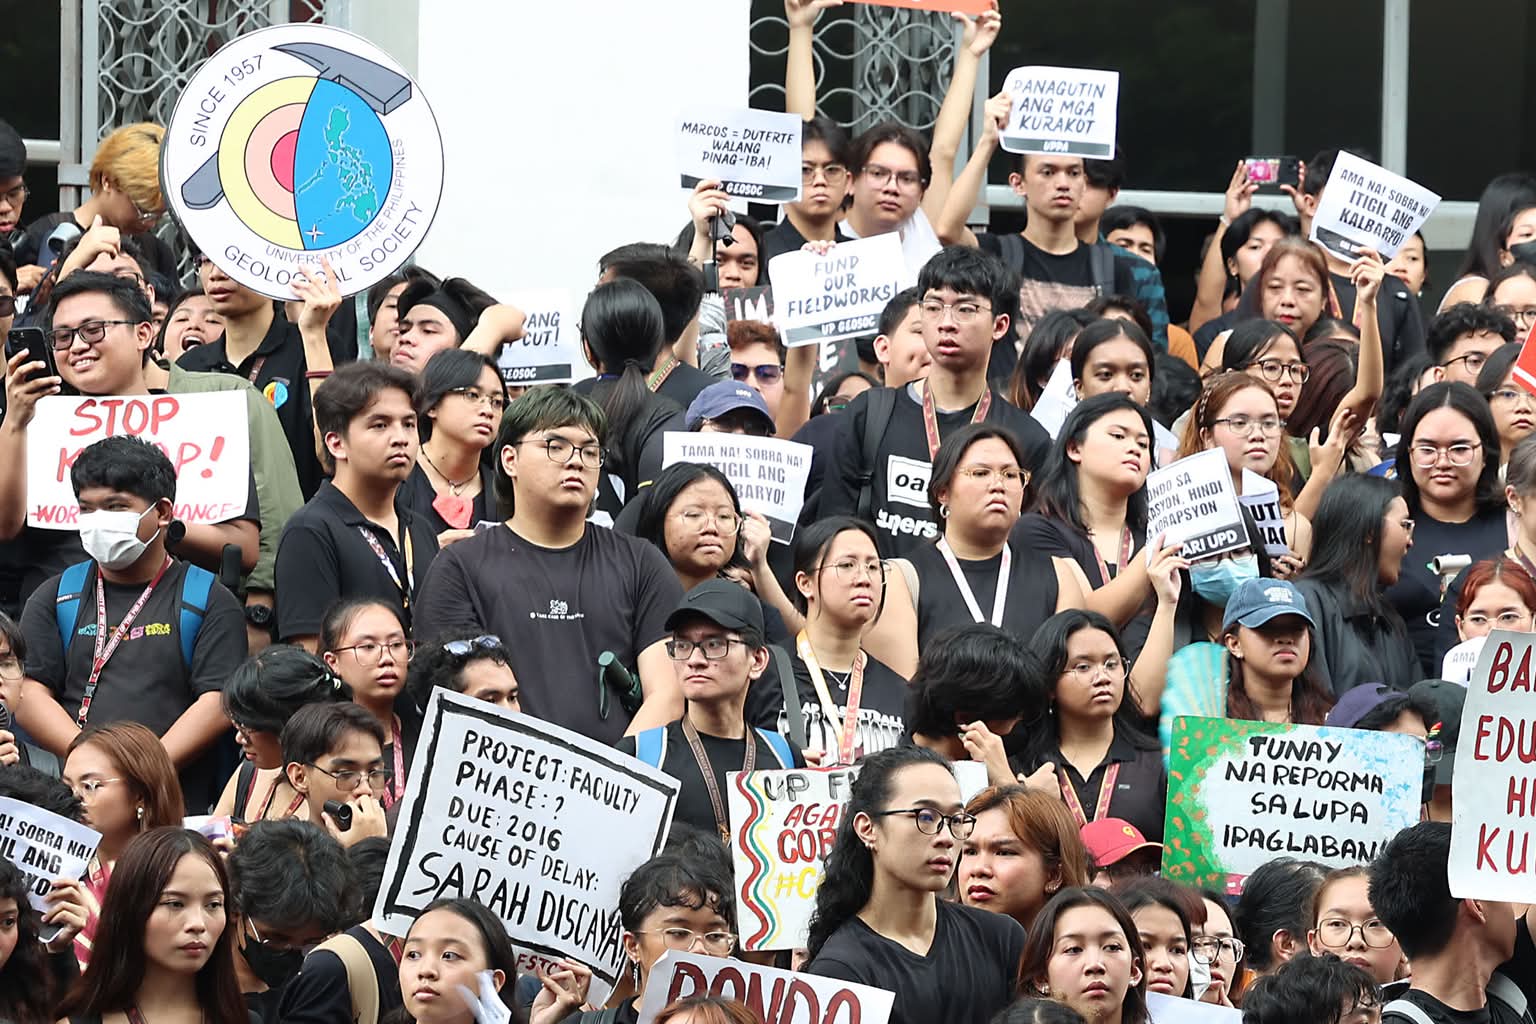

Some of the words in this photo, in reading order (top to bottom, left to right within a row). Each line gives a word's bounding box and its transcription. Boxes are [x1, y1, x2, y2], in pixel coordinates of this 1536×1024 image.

[190, 86, 226, 147] SINCE
[224, 54, 264, 87] 1957
[1013, 79, 1106, 99] PANAGUTIN
[1019, 96, 1054, 113] ANG
[1059, 100, 1095, 116] MGA
[680, 121, 729, 139] MARCOS
[742, 127, 796, 145] DUTERTE
[1018, 115, 1095, 134] KURAKOT
[701, 152, 773, 170] PINAG-IBA!
[711, 138, 761, 155] WALANG
[265, 244, 344, 266] UNIVERSITY
[348, 238, 365, 255] OF
[366, 222, 387, 246] THE
[383, 138, 406, 223] PHILIPPINES
[1340, 168, 1365, 187] AMA
[1366, 180, 1387, 197] NA!
[1388, 188, 1419, 214] SOBRA
[1349, 189, 1388, 218] ITIGIL
[1391, 208, 1414, 231] ANG
[359, 200, 424, 272] SOCIETY
[1339, 207, 1405, 248] KALBARYO!
[813, 254, 860, 280] FUND
[823, 273, 857, 292] OUR
[786, 281, 900, 319] FIELDWORKS!
[525, 311, 561, 330] ANG
[821, 323, 836, 337] UP
[69, 396, 180, 438] STOP
[681, 445, 715, 459] TAMA
[719, 446, 741, 459] NA!
[745, 447, 784, 465] SOBRA
[706, 461, 751, 478] TIGIL
[757, 465, 786, 484] ANG
[1176, 471, 1193, 488] SA
[735, 481, 785, 507] BARYO!
[1188, 480, 1224, 502] HINDI
[1208, 530, 1238, 550] UPD
[1249, 735, 1343, 764] TUNAY
[462, 729, 567, 784] PROJECT:
[569, 766, 641, 816] FACULTY
[763, 771, 810, 802] UP
[1225, 760, 1266, 784] NA
[1272, 764, 1384, 795] REPORMA
[447, 795, 501, 829] DUE:
[506, 815, 563, 852] 2016
[1250, 792, 1288, 815] SA
[1293, 797, 1369, 825] LUPA
[16, 820, 64, 851] SOBRA
[66, 839, 93, 862] NA!
[21, 845, 63, 876] ANG
[442, 824, 503, 861] CAUSE
[507, 845, 536, 870] OF
[541, 854, 600, 893] DELAY:
[412, 851, 531, 926] SARAH
